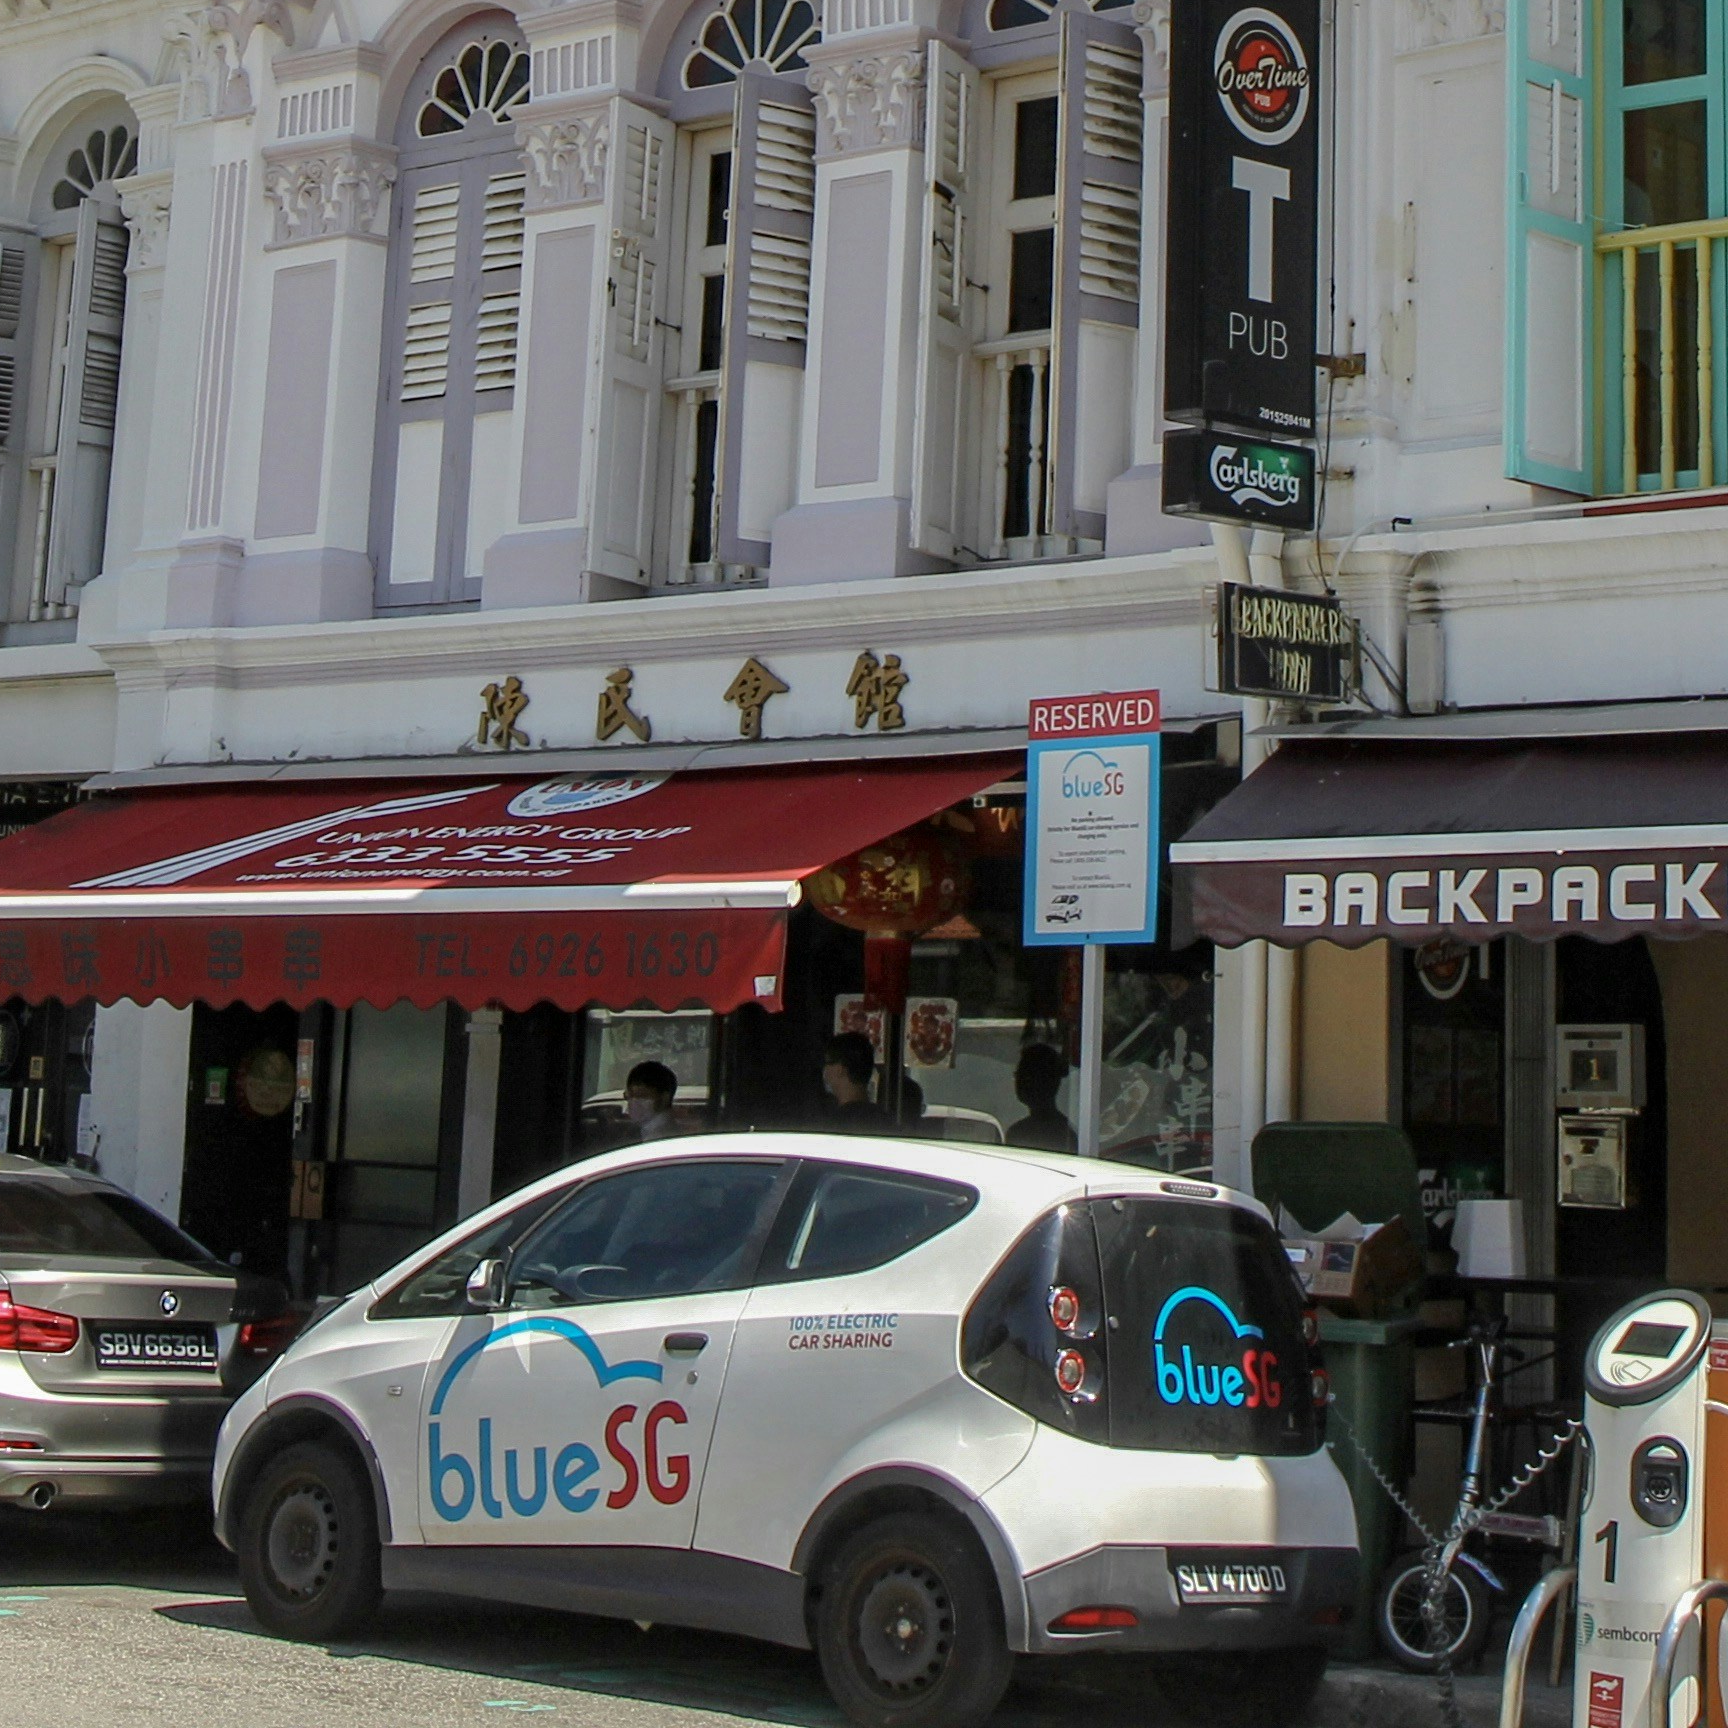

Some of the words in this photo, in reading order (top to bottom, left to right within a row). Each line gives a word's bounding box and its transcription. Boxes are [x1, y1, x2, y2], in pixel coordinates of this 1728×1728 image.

[1254, 93, 1271, 107] PUB
[1232, 155, 1291, 303] T
[1229, 311, 1288, 360] PUB
[1210, 445, 1300, 504] Carlsberg
[1034, 699, 1154, 732] RESERVED
[1062, 772, 1125, 799] blueSG
[316, 825, 436, 846] UNION
[427, 823, 561, 842] ENERGY
[558, 825, 693, 842] GROUP
[274, 845, 447, 869] 6333
[440, 844, 634, 866] 5555
[414, 933, 490, 978] TEL:
[508, 932, 607, 977] 6926
[626, 930, 720, 978] 1630
[789, 1315, 824, 1330] 100%
[826, 1313, 899, 1329] ELECTRIC
[99, 1332, 215, 1357] SBV6636L
[788, 1334, 820, 1350] CAR
[822, 1332, 893, 1349] SHARING
[1154, 1343, 1282, 1408] blueSG
[428, 1400, 690, 1522] blueSG
[1594, 1520, 1619, 1584] 1
[1176, 1565, 1286, 1593] SLV4700D
